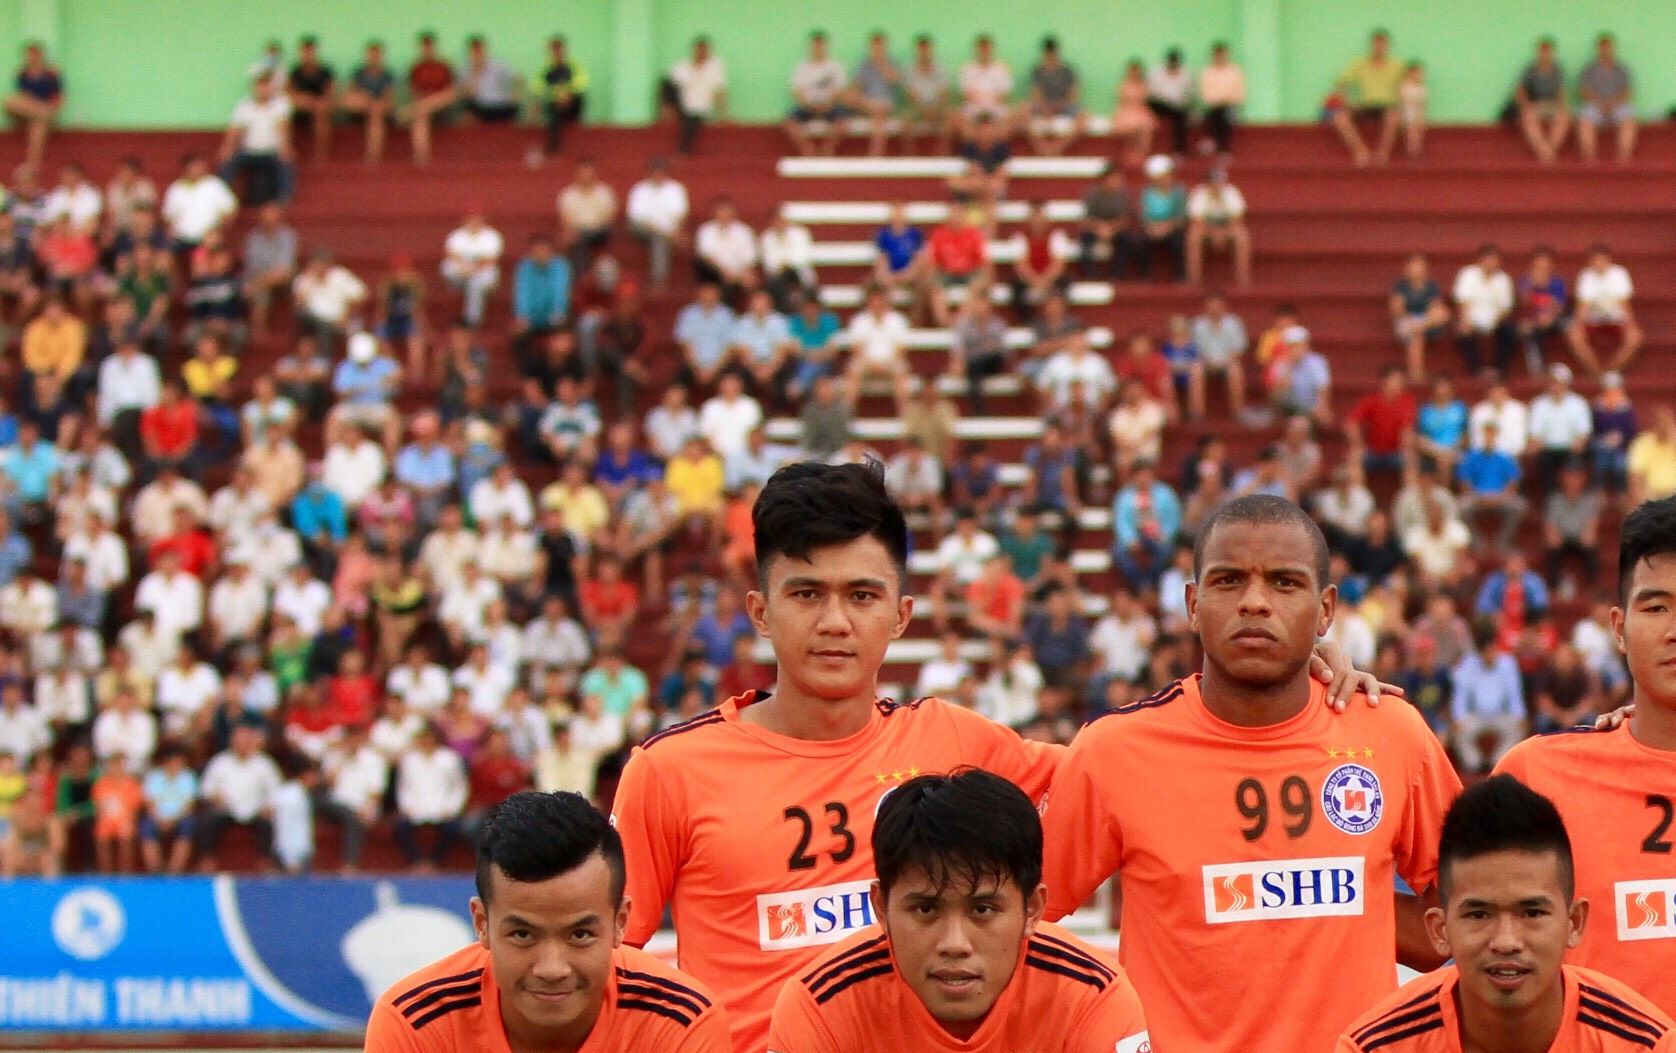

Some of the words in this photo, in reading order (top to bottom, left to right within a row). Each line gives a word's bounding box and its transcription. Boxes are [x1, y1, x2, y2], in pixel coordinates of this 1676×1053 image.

[1235, 774, 1314, 842] 99
[783, 801, 857, 872] 23
[813, 890, 871, 934] SH
[1261, 868, 1356, 909] SHB
